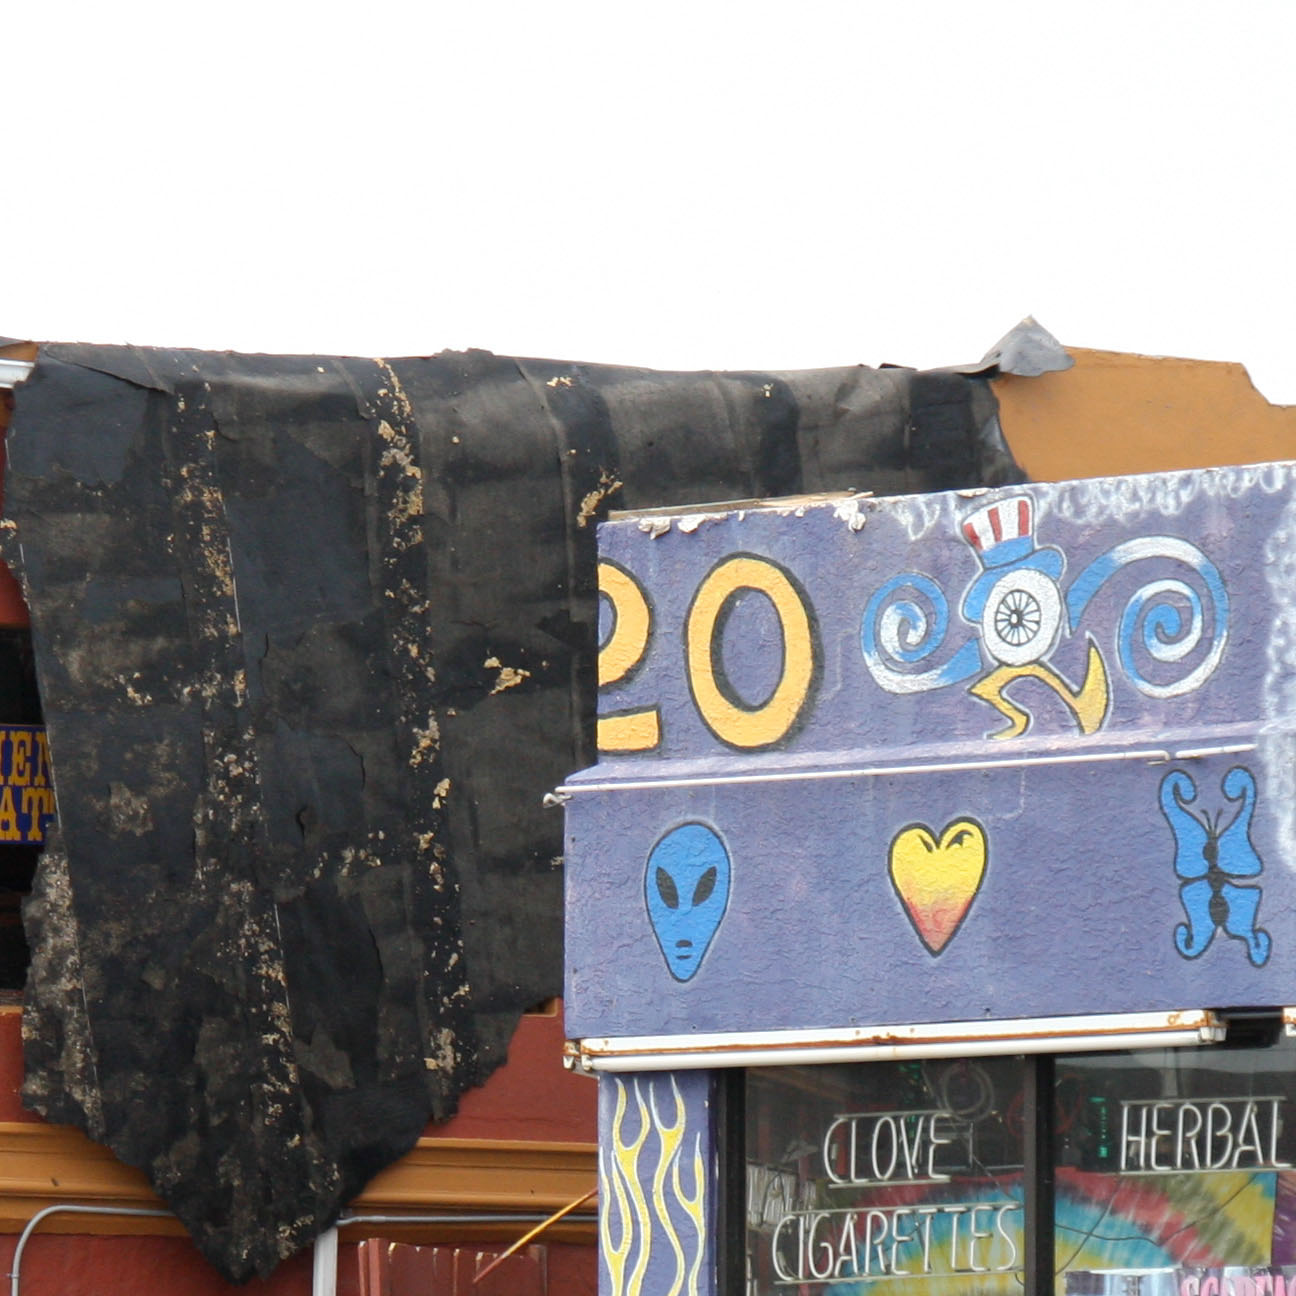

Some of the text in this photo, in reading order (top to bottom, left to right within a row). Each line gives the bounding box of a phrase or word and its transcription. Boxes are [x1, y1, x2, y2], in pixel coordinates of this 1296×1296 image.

[823, 1112, 953, 1184] CLOVE
[1120, 1100, 1293, 1172] HERBAL
[772, 1203, 1018, 1281] CIGARETTES
